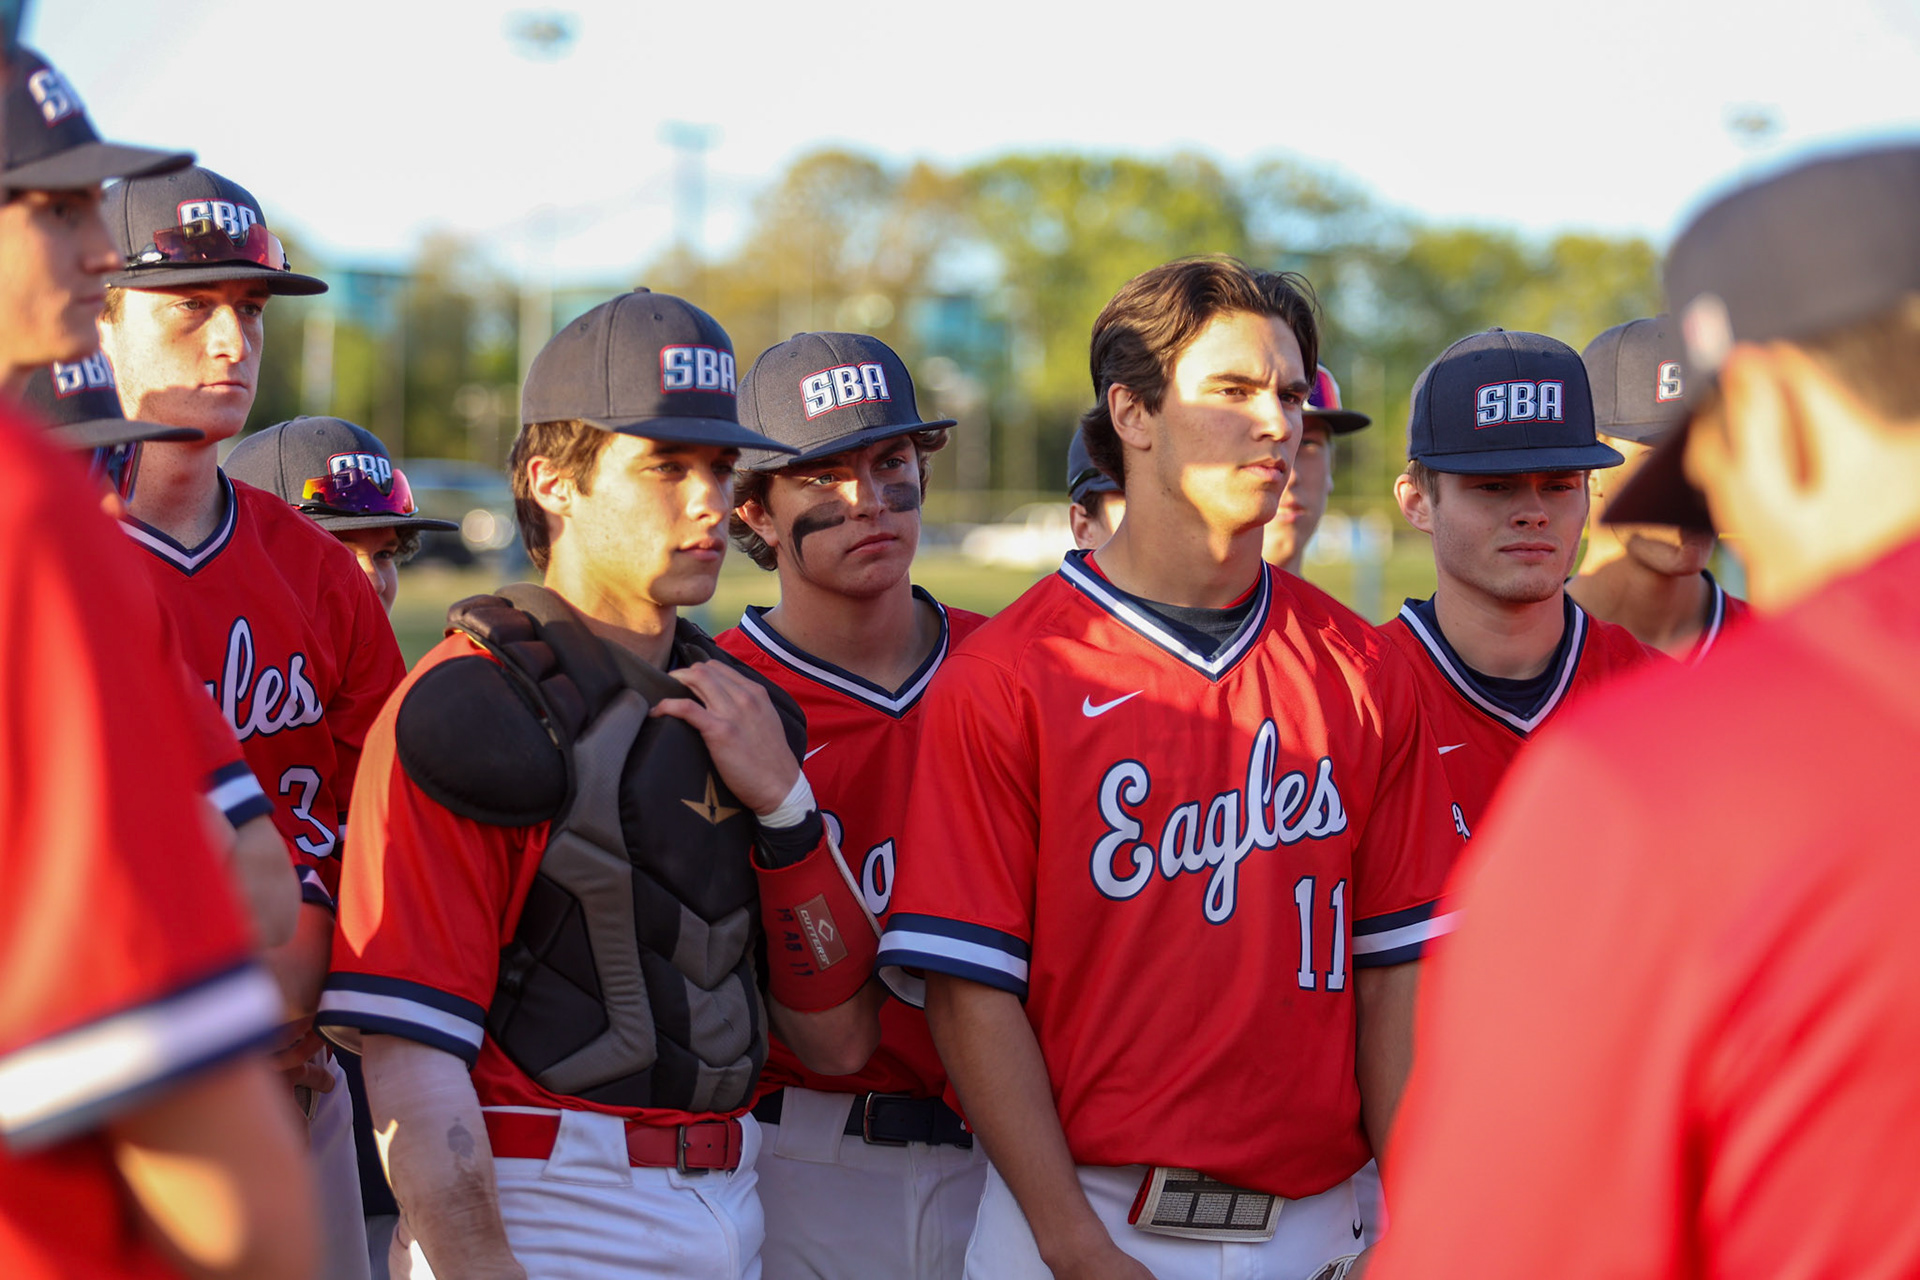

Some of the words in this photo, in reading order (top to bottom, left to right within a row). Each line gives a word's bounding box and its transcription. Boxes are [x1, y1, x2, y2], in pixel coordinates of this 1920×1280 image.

[660, 344, 737, 398] SBA
[800, 362, 892, 420] SBA
[1475, 380, 1565, 429] SBA
[203, 616, 324, 742] les
[279, 765, 336, 859] 3
[1089, 717, 1348, 925] Eagles
[800, 909, 830, 965] CUTTERS
[1294, 876, 1347, 992] 11
